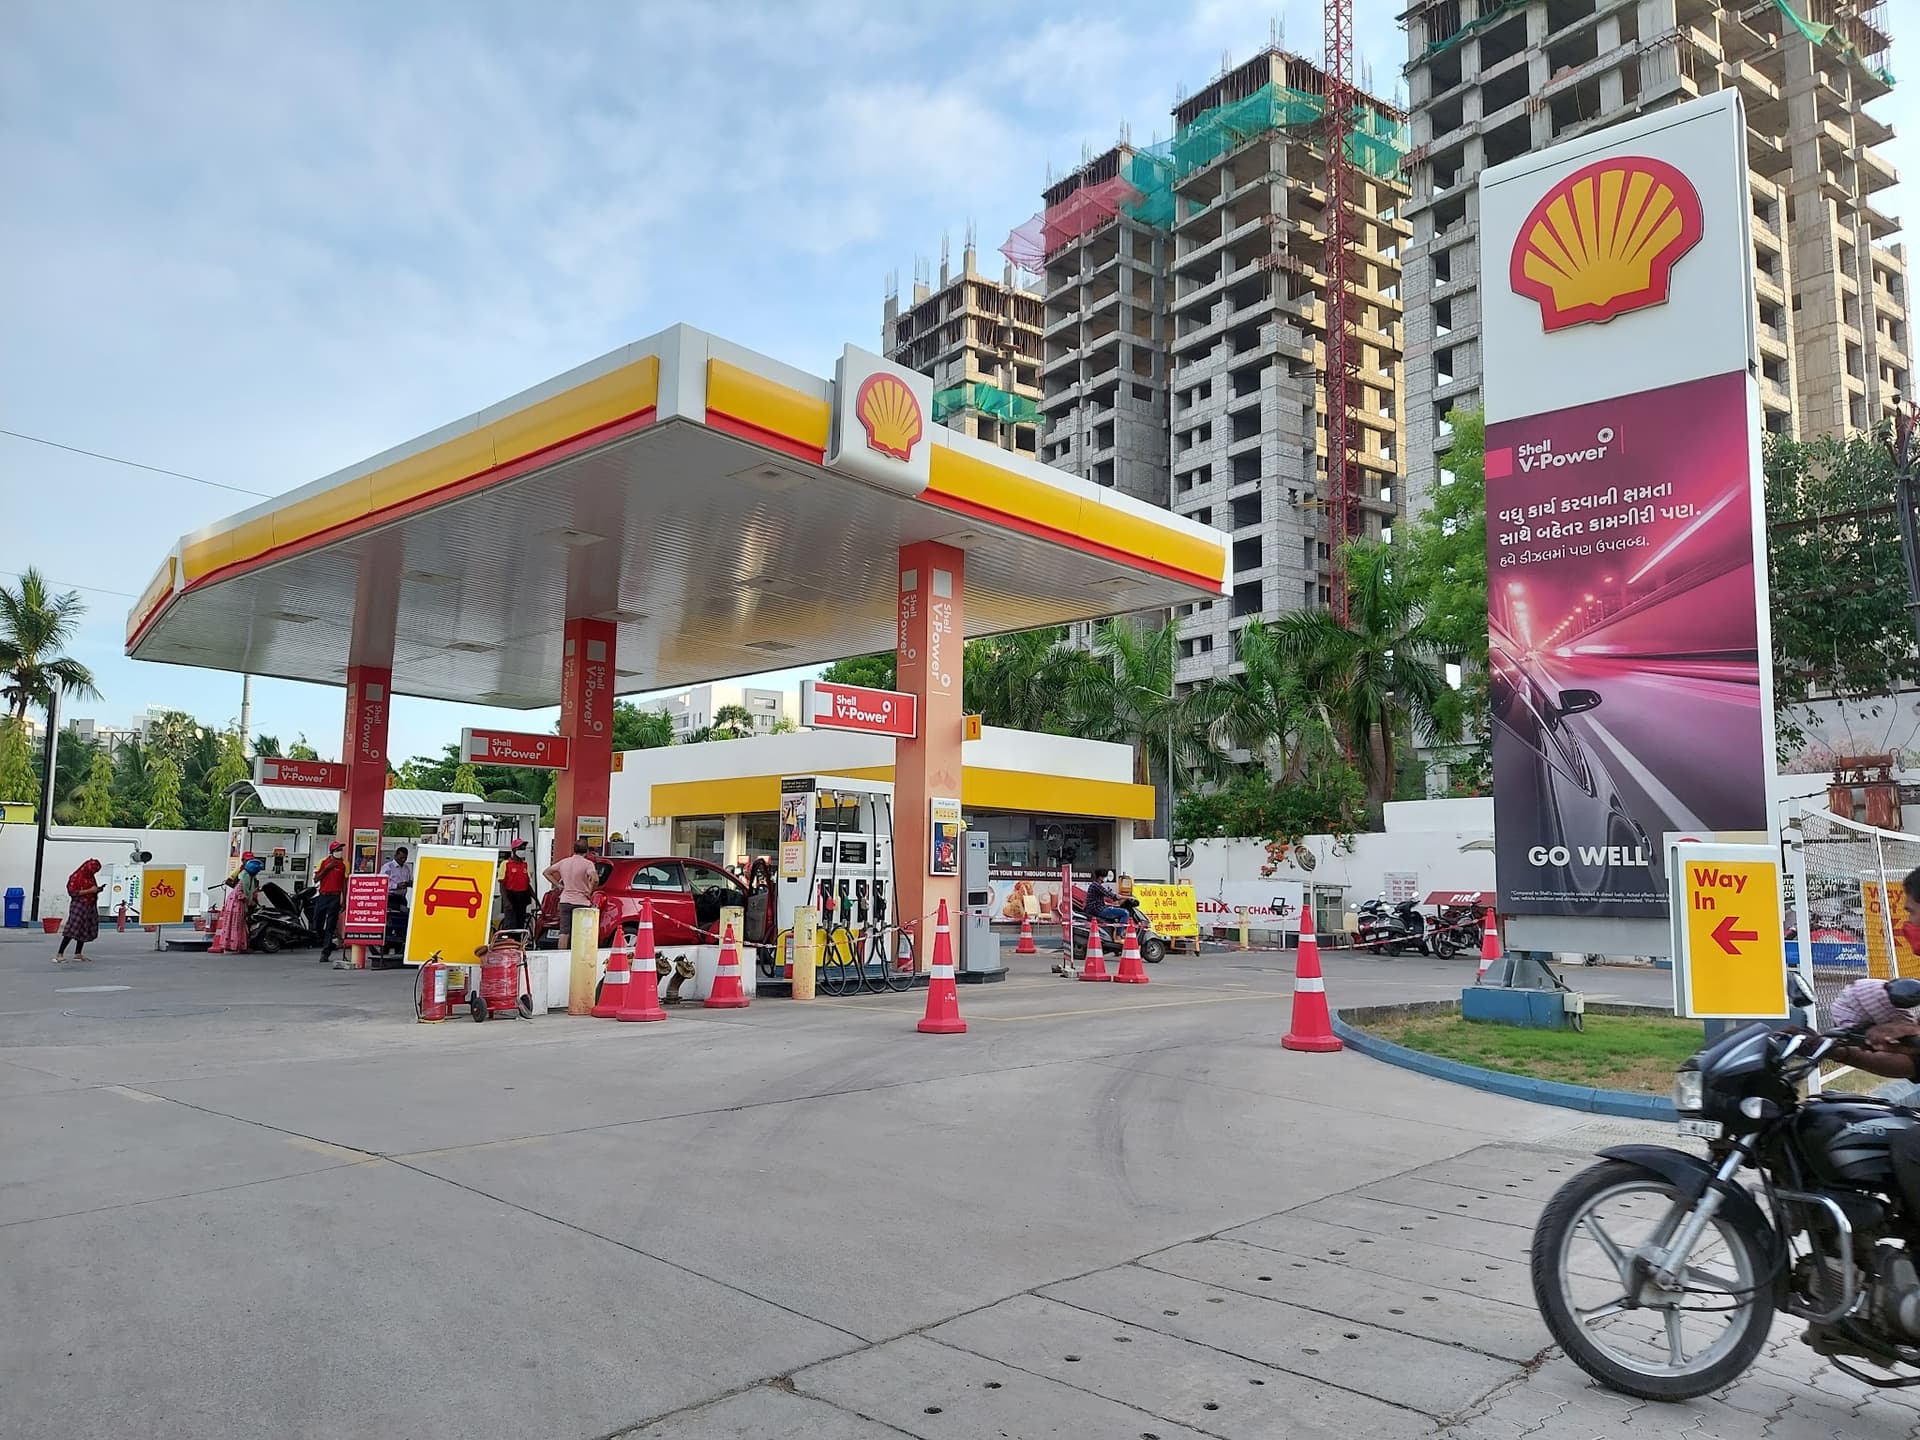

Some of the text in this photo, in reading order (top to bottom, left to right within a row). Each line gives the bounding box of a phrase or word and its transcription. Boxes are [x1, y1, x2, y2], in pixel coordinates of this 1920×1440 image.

[1518, 440, 1551, 457] Shell
[1519, 446, 1607, 472] V-Power
[1499, 482, 1672, 525] વધુ કાર્ય કરવાની ક્ષમતા
[1499, 525, 1531, 545] સાથે
[1537, 521, 1584, 539] બહેતર
[1589, 504, 1655, 532] કામગીરી
[1499, 551, 1516, 567] હવે
[1520, 544, 1566, 564] ડીઝલમાં
[1569, 545, 1592, 557] પણ
[900, 595, 910, 656] V-Power
[943, 604, 952, 634] Shell
[931, 603, 943, 680] V-Power
[597, 665, 605, 690] Shell
[584, 665, 597, 727] V-Power
[836, 694, 857, 706] Shell
[836, 706, 888, 724] V-Power
[362, 704, 375, 754] V-Power
[971, 722, 977, 734] 1
[492, 739, 512, 747] Shell
[493, 747, 541, 760] V-Power
[281, 772, 324, 782] V-Power
[1528, 846, 1649, 866] GO WELL
[1693, 868, 1748, 894] Way
[1196, 902, 1229, 913] ELIX
[1695, 891, 1715, 910] In
